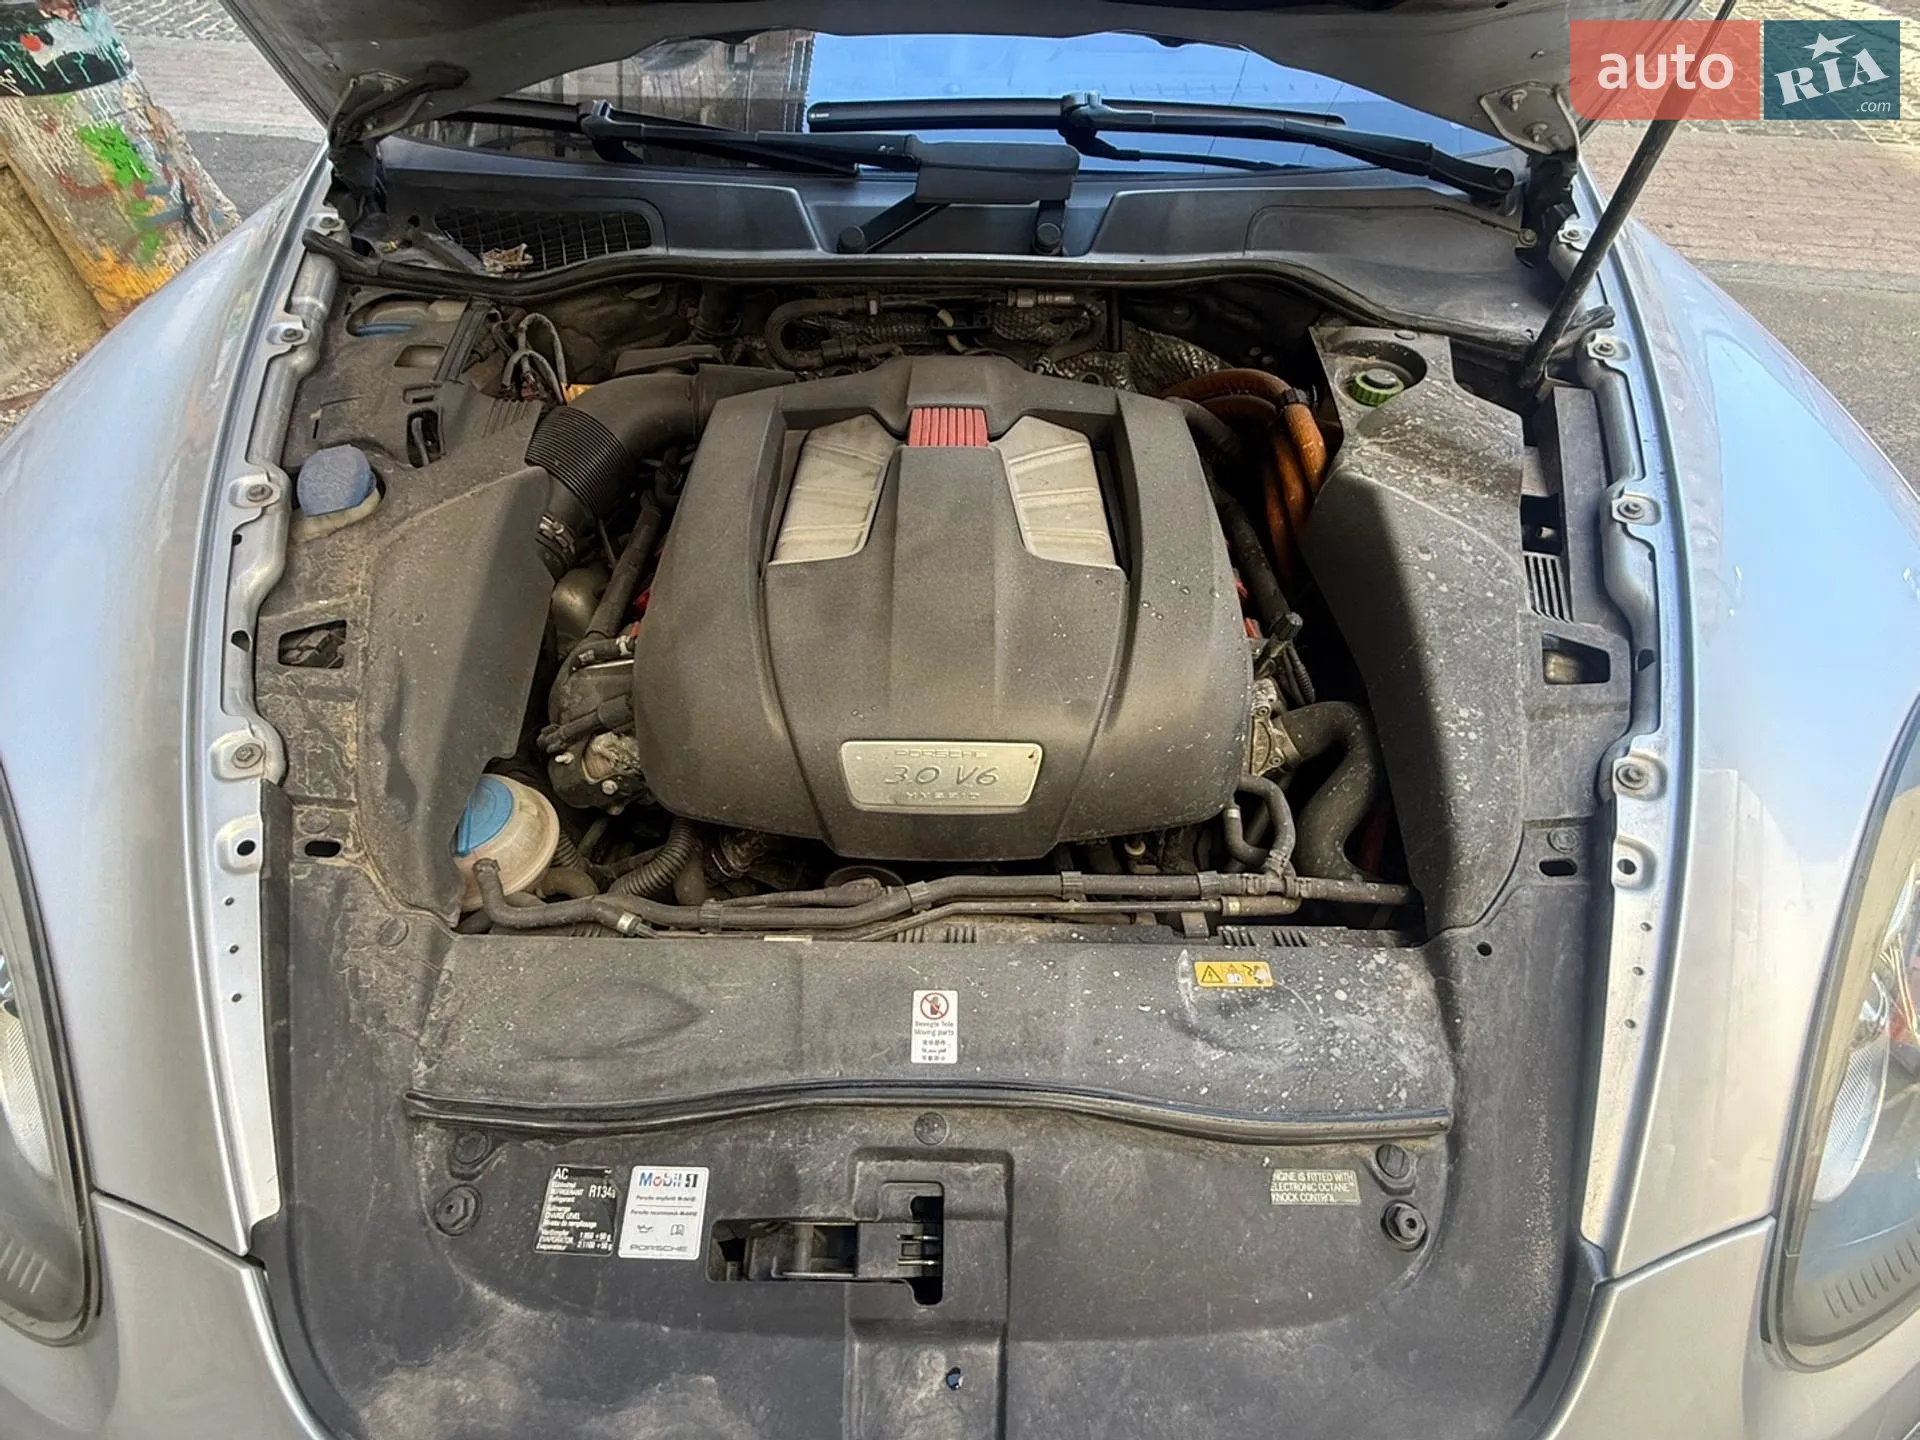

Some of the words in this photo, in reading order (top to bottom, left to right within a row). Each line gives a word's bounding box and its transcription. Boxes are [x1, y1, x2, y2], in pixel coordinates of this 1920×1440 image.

[894, 748, 988, 759] PORSCHE
[956, 766, 1000, 786] V6
[553, 1168, 569, 1180] AC
[639, 1172, 683, 1187] Mobil
[629, 1244, 688, 1252] PORSCHE
